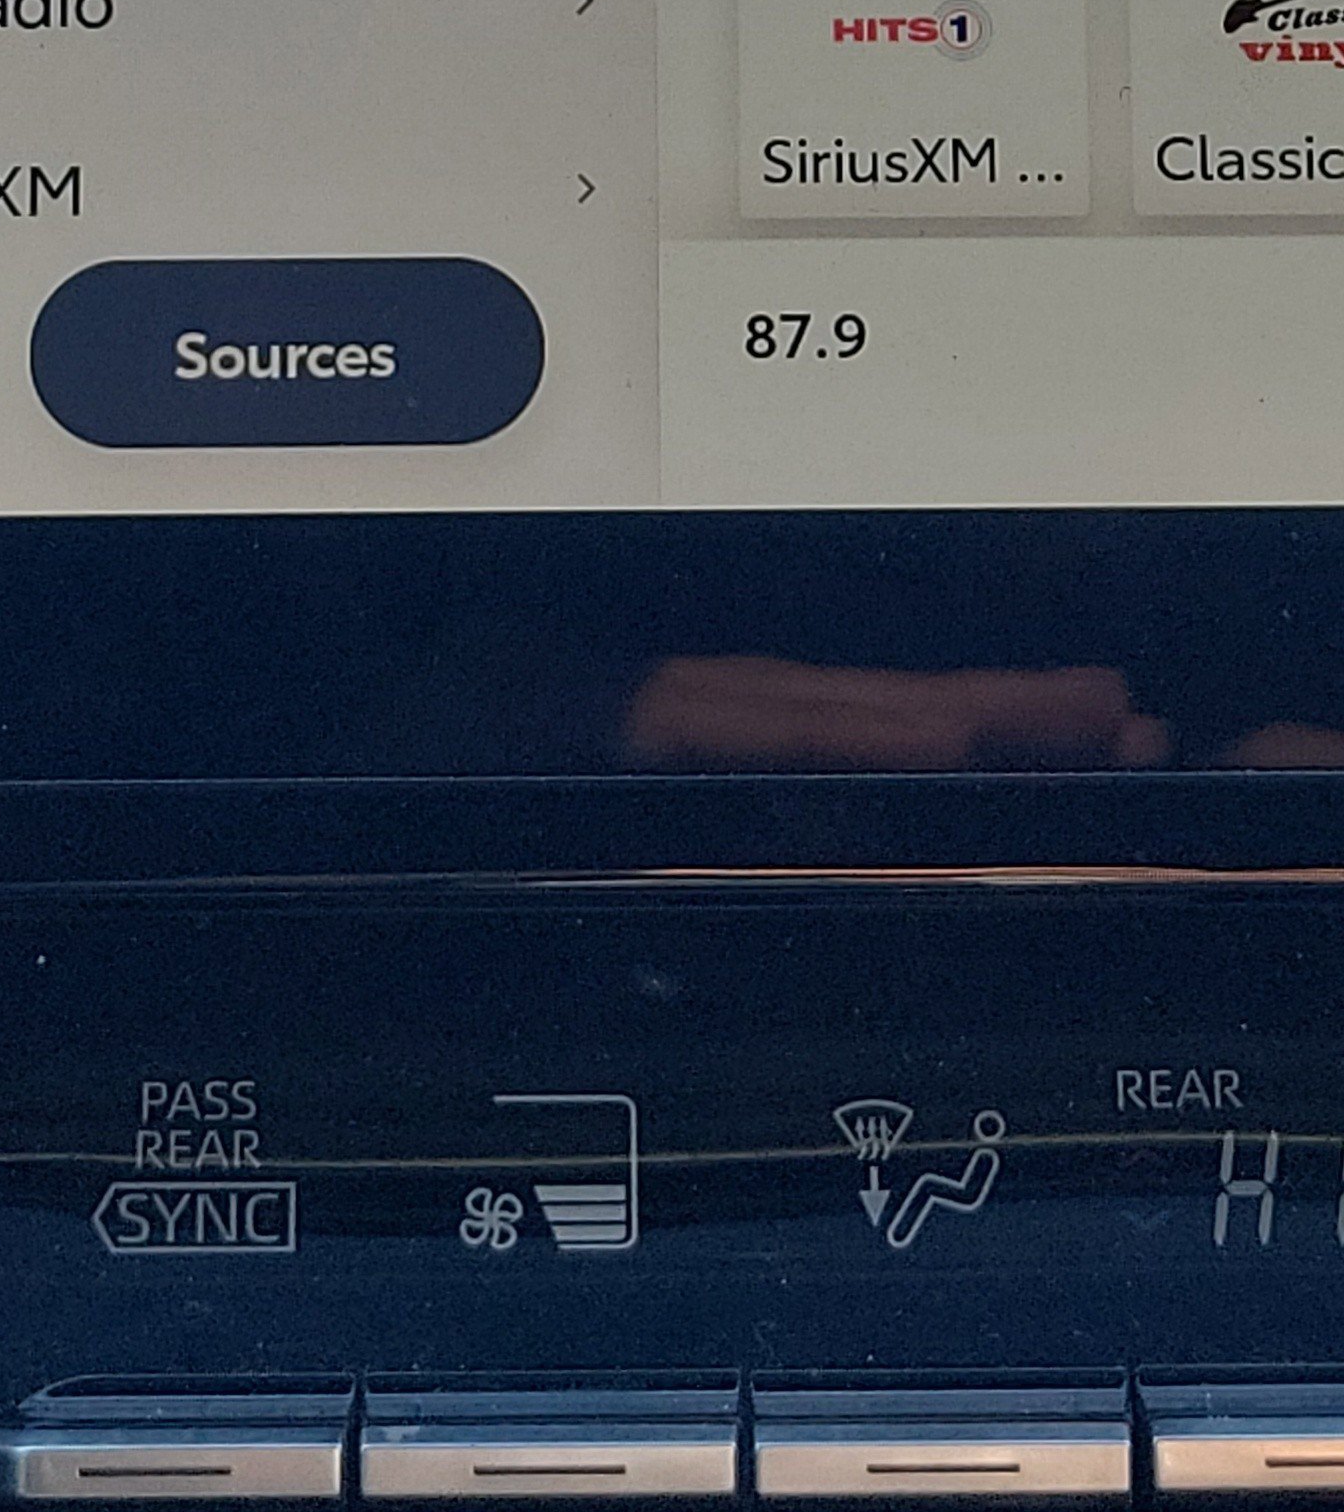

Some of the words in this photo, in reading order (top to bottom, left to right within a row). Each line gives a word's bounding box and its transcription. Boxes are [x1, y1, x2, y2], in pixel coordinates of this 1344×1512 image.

[832, 17, 939, 42] HITS
[763, 137, 996, 184] SiriusXM
[175, 332, 396, 379] Sources
[745, 313, 866, 359] 87.9
[141, 1080, 257, 1122] PASS
[1116, 1068, 1244, 1111] REAR
[134, 1129, 262, 1171] REAR
[116, 1193, 281, 1244] SYNC
